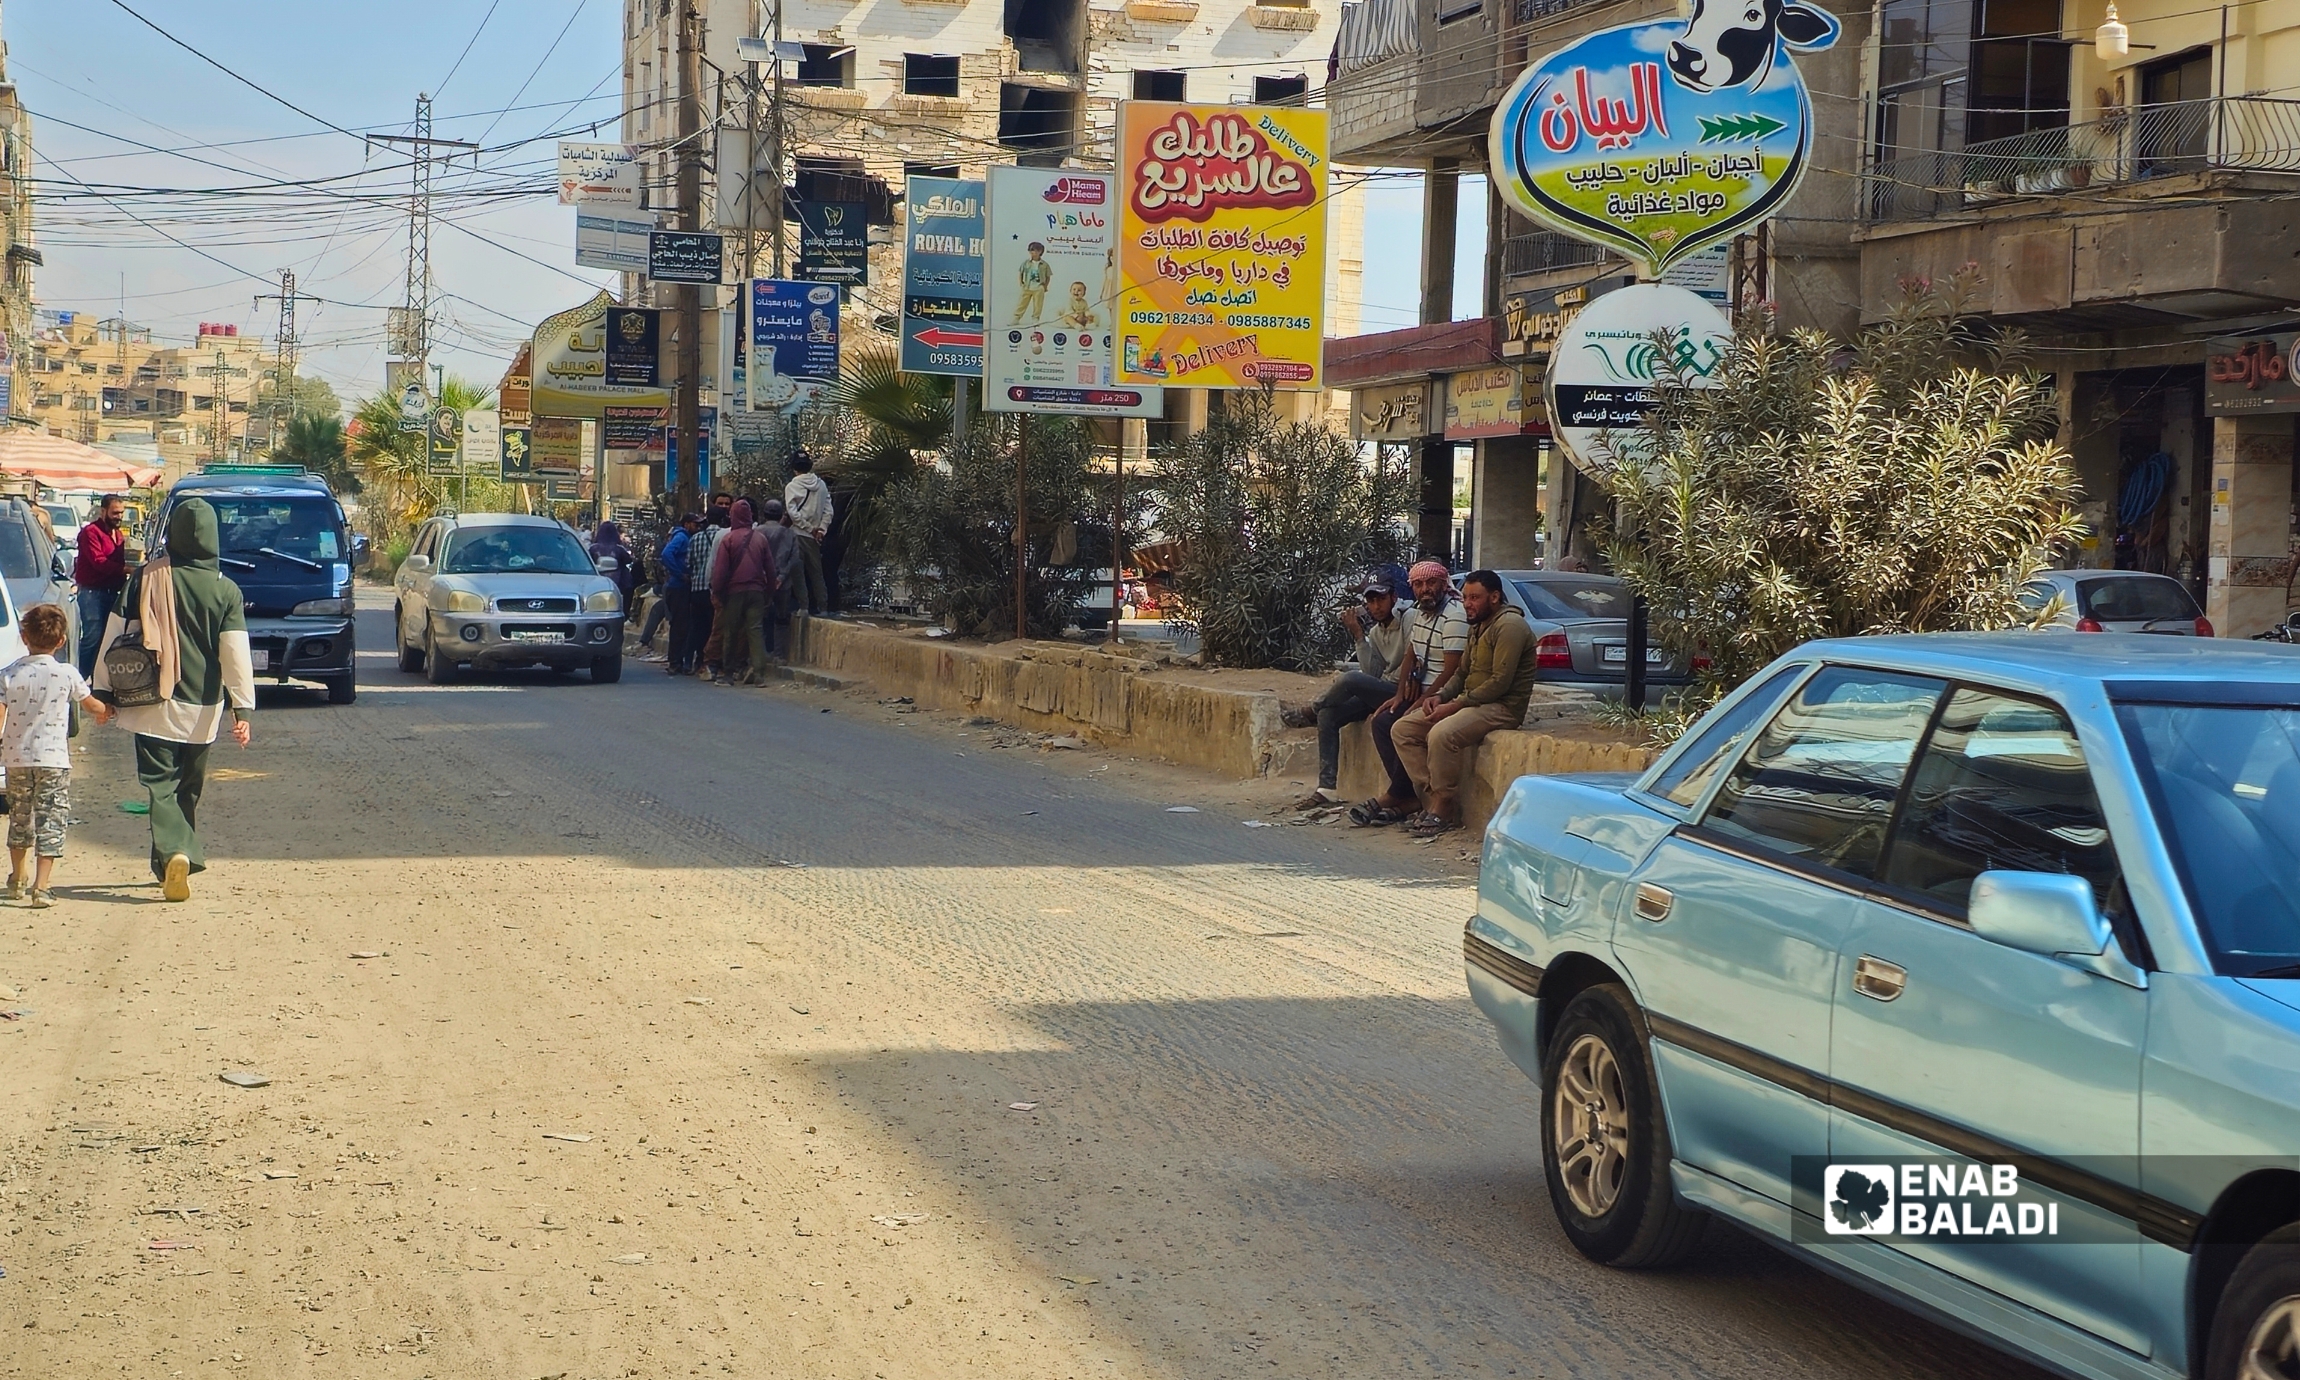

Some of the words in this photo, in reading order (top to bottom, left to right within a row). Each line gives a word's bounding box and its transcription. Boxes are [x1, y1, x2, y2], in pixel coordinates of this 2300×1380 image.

[1539, 62, 1670, 154] البيان
[1152, 115, 1256, 167] طلبك
[1257, 114, 1320, 168] Delivery
[562, 145, 598, 163] الشاميات
[600, 149, 633, 165] صيدلية
[1705, 146, 1763, 180] أجبان
[1565, 162, 1625, 191] حليب
[1643, 150, 1690, 185] ألبان
[1071, 180, 1101, 190] Mama
[1139, 154, 1301, 209] عالسريع
[1071, 189, 1101, 199] Hieam
[1677, 190, 1726, 216] مواد
[912, 195, 977, 224] الملكي
[1606, 191, 1674, 222] غذائية
[1046, 210, 1078, 230] هيام
[1079, 211, 1105, 228] ماما
[672, 237, 701, 248] المحامي
[914, 233, 966, 256] ROYAL
[1139, 229, 1204, 251] الطلبات
[1207, 226, 1251, 251] كافة
[1251, 232, 1306, 261] توصيل
[651, 249, 678, 260] الحاجي
[698, 251, 720, 262] جمال
[1230, 260, 1269, 285] داريا
[1272, 262, 1291, 289] في
[1185, 287, 1218, 306] نصل
[1220, 289, 1258, 308] اتصل
[912, 299, 961, 318] للتجارة
[756, 315, 803, 327] مايسترو
[1130, 311, 1214, 326] 0962182434
[1227, 314, 1311, 330] 0985887345
[1170, 334, 1259, 377] Delivery
[598, 385, 627, 393] PALACE
[1485, 370, 1511, 389] مكتب
[1100, 395, 1113, 403] متر
[1114, 394, 1130, 403] 250
[1572, 407, 1607, 424] فرنسي
[108, 661, 145, 675] COCO
[118, 692, 156, 703] CHANEL
